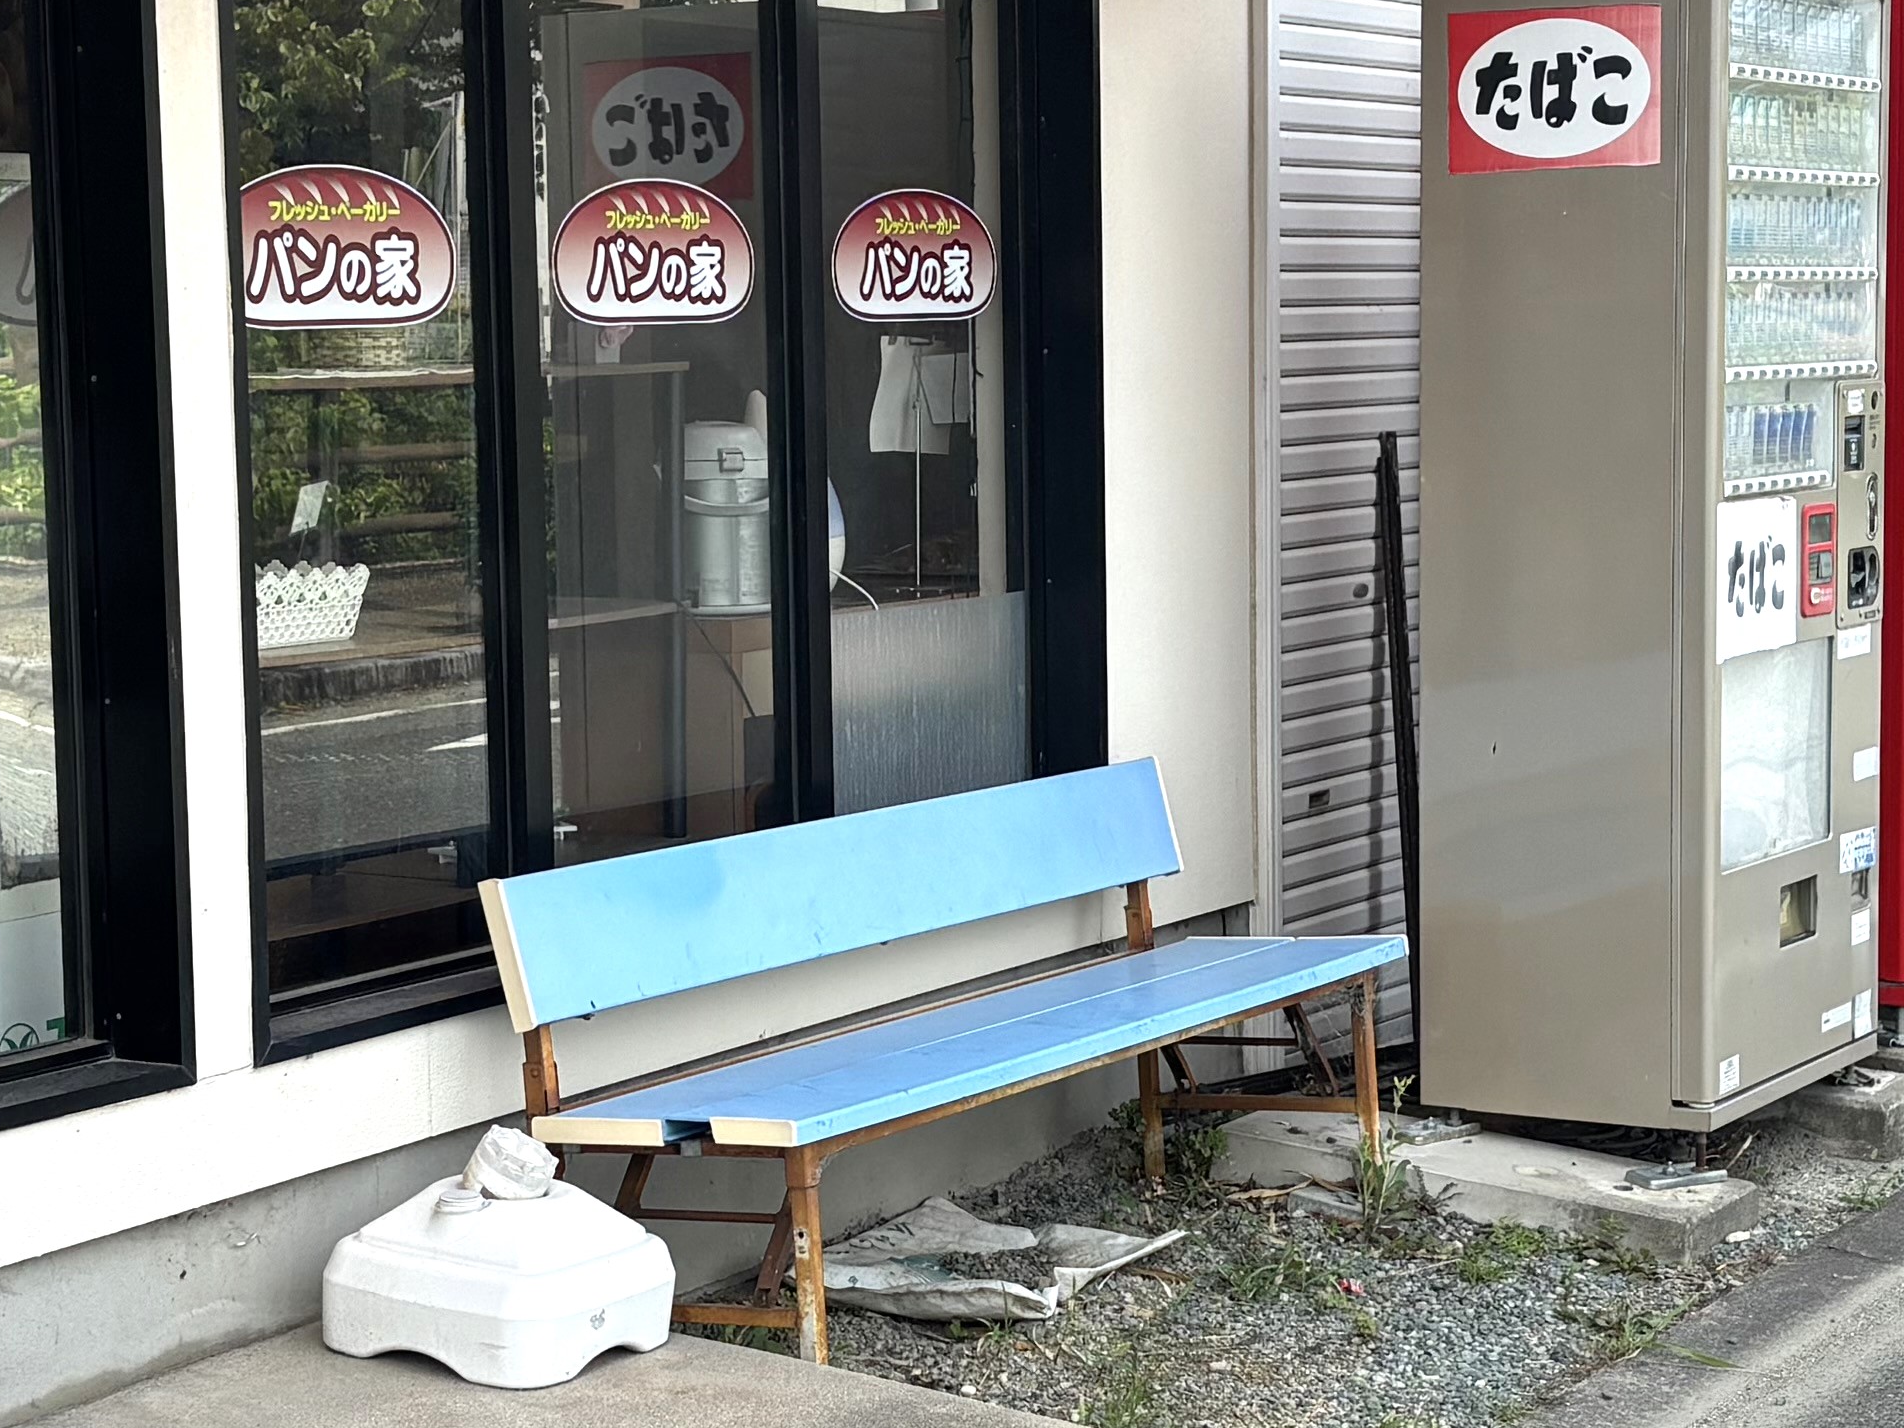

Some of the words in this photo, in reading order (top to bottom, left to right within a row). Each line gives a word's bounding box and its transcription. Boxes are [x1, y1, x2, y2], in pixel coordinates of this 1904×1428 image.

[1474, 44, 1632, 131] たばこ
[248, 228, 419, 302] パンの家
[589, 234, 725, 301] パンの家
[862, 241, 972, 300] パンの家
[1727, 534, 1786, 618] たばこ
